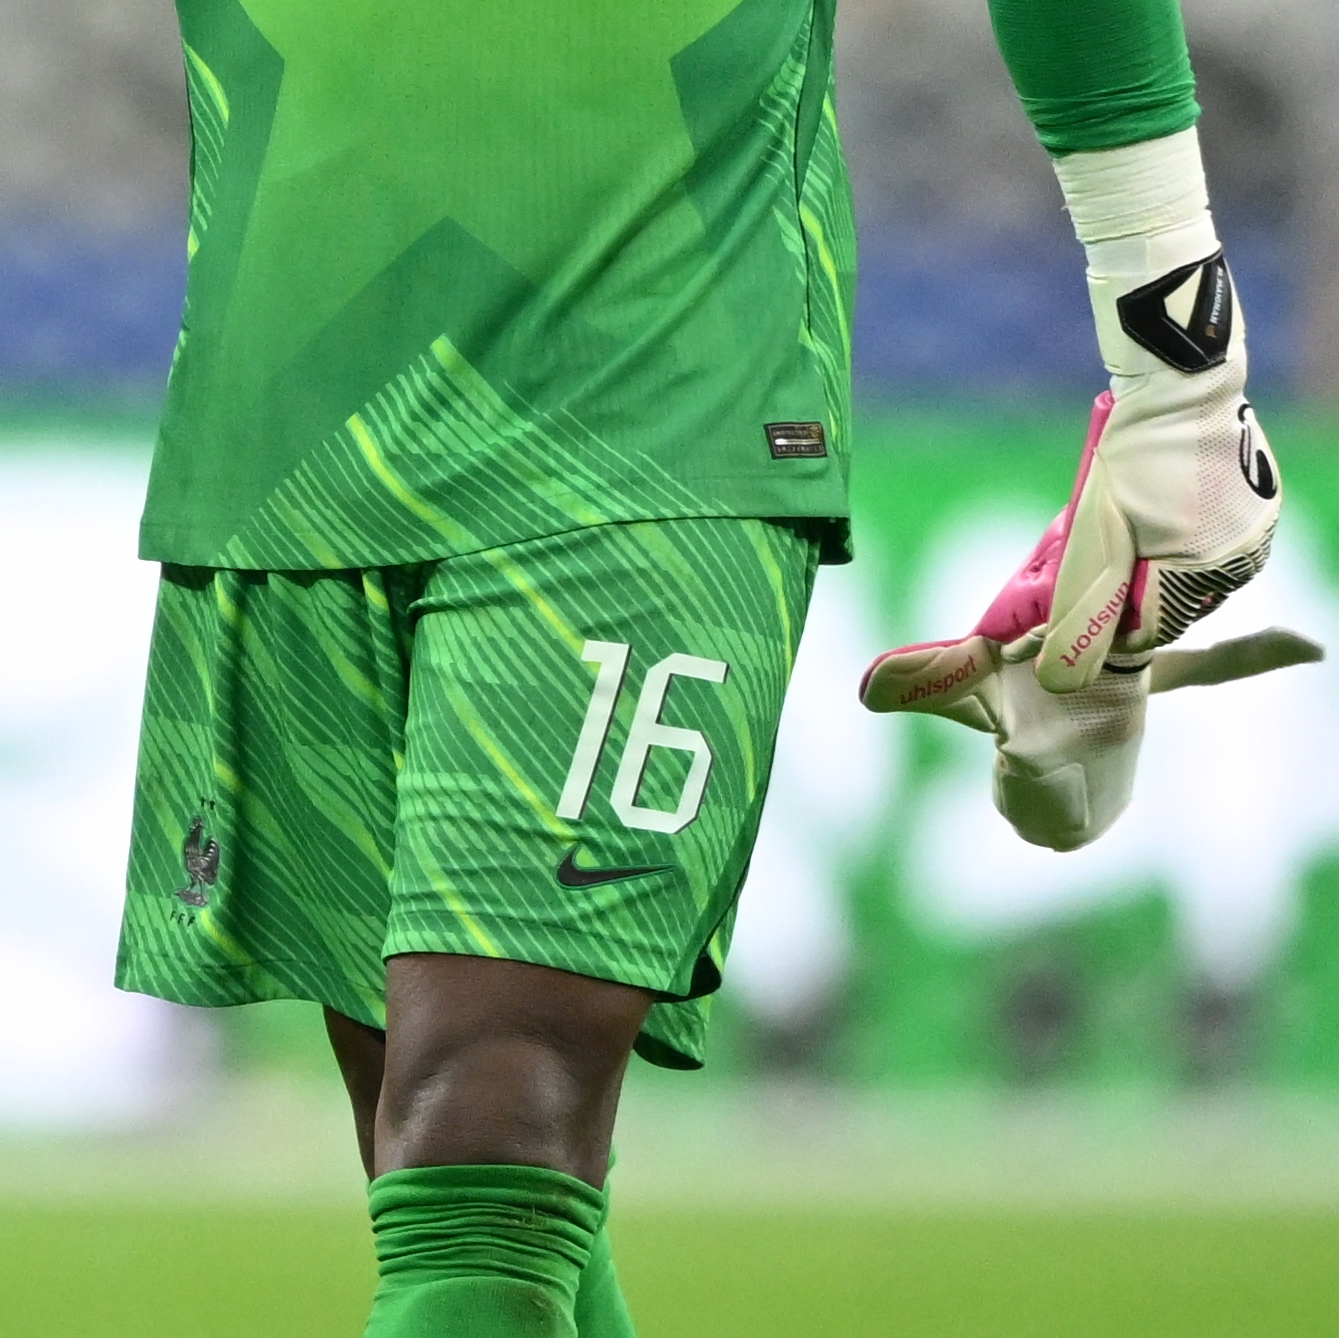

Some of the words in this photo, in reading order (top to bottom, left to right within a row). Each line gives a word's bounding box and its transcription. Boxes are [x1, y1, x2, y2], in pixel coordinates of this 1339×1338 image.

[1059, 581, 1130, 668] uhlsport
[900, 654, 977, 705] uhlsport
[555, 638, 730, 835] 16
